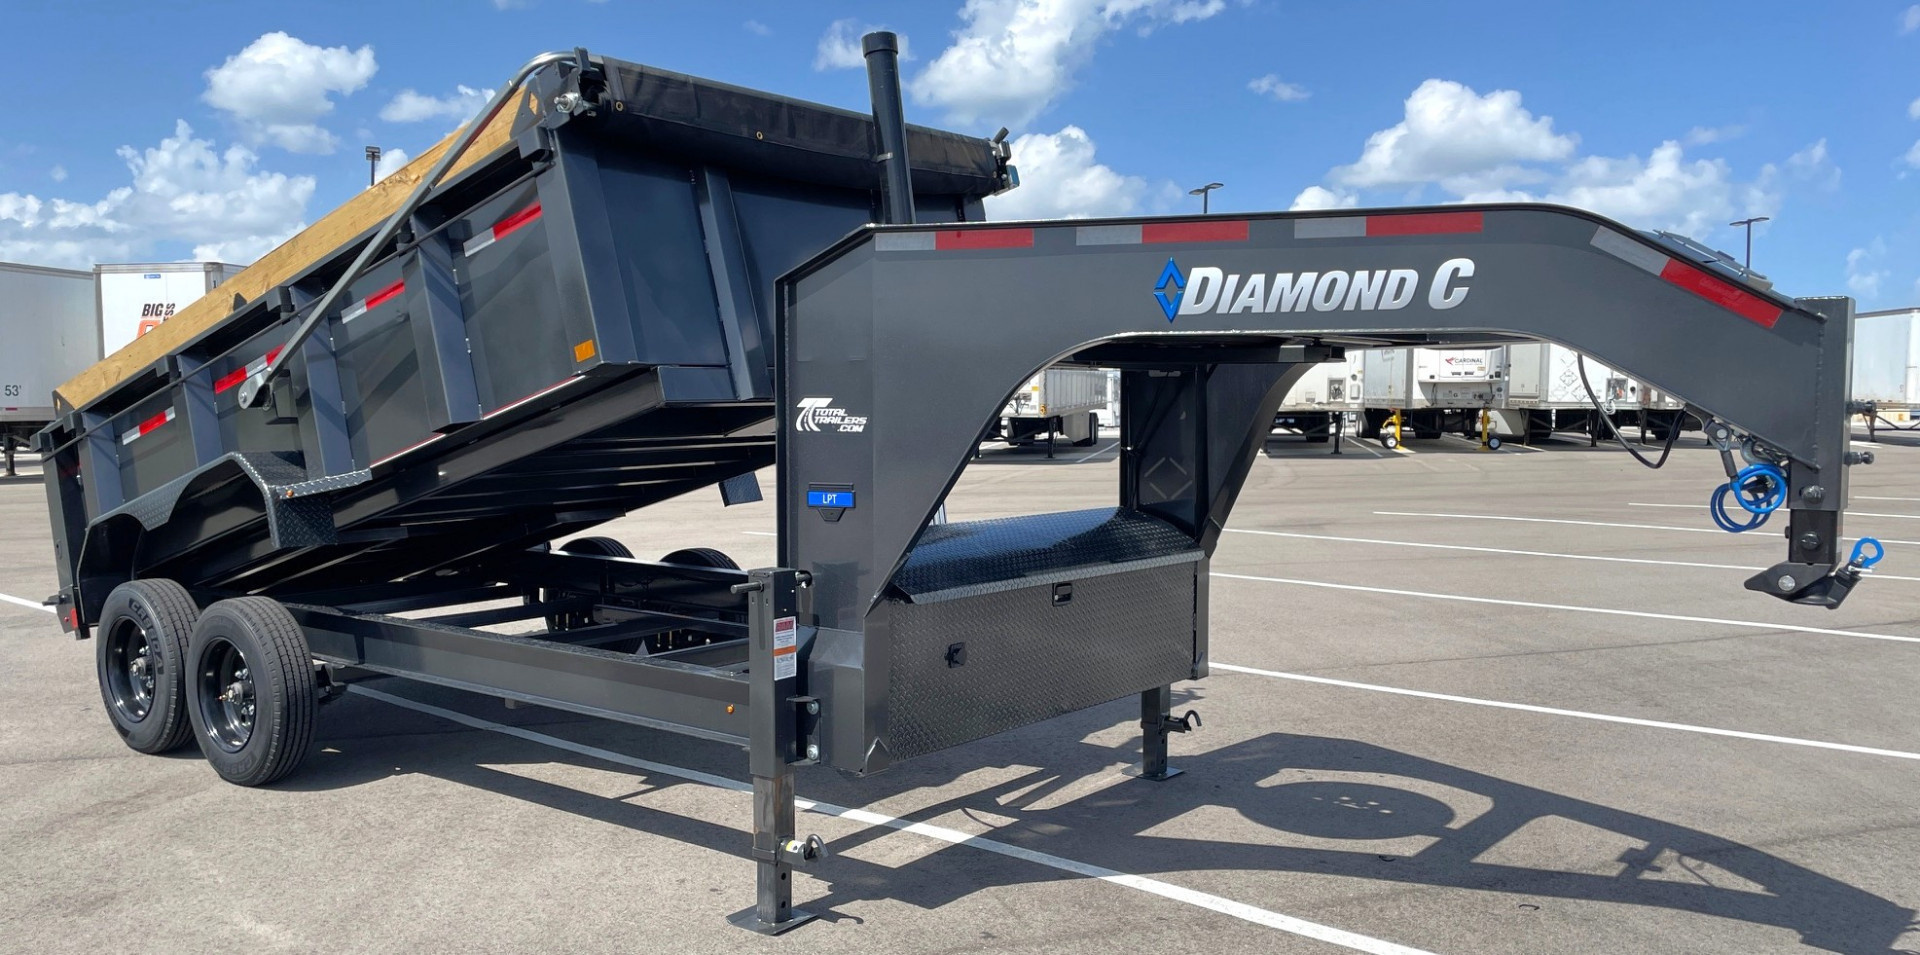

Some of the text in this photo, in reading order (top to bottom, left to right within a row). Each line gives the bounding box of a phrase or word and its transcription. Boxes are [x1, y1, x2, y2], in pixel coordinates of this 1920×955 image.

[1177, 257, 1475, 315] DIAMOND C
[141, 303, 164, 317] BIG
[4, 384, 22, 397] 53'
[815, 408, 848, 416] TOTAL
[814, 416, 868, 424] TRAILERS
[837, 424, 865, 432] .COM
[822, 494, 837, 504] LPT
